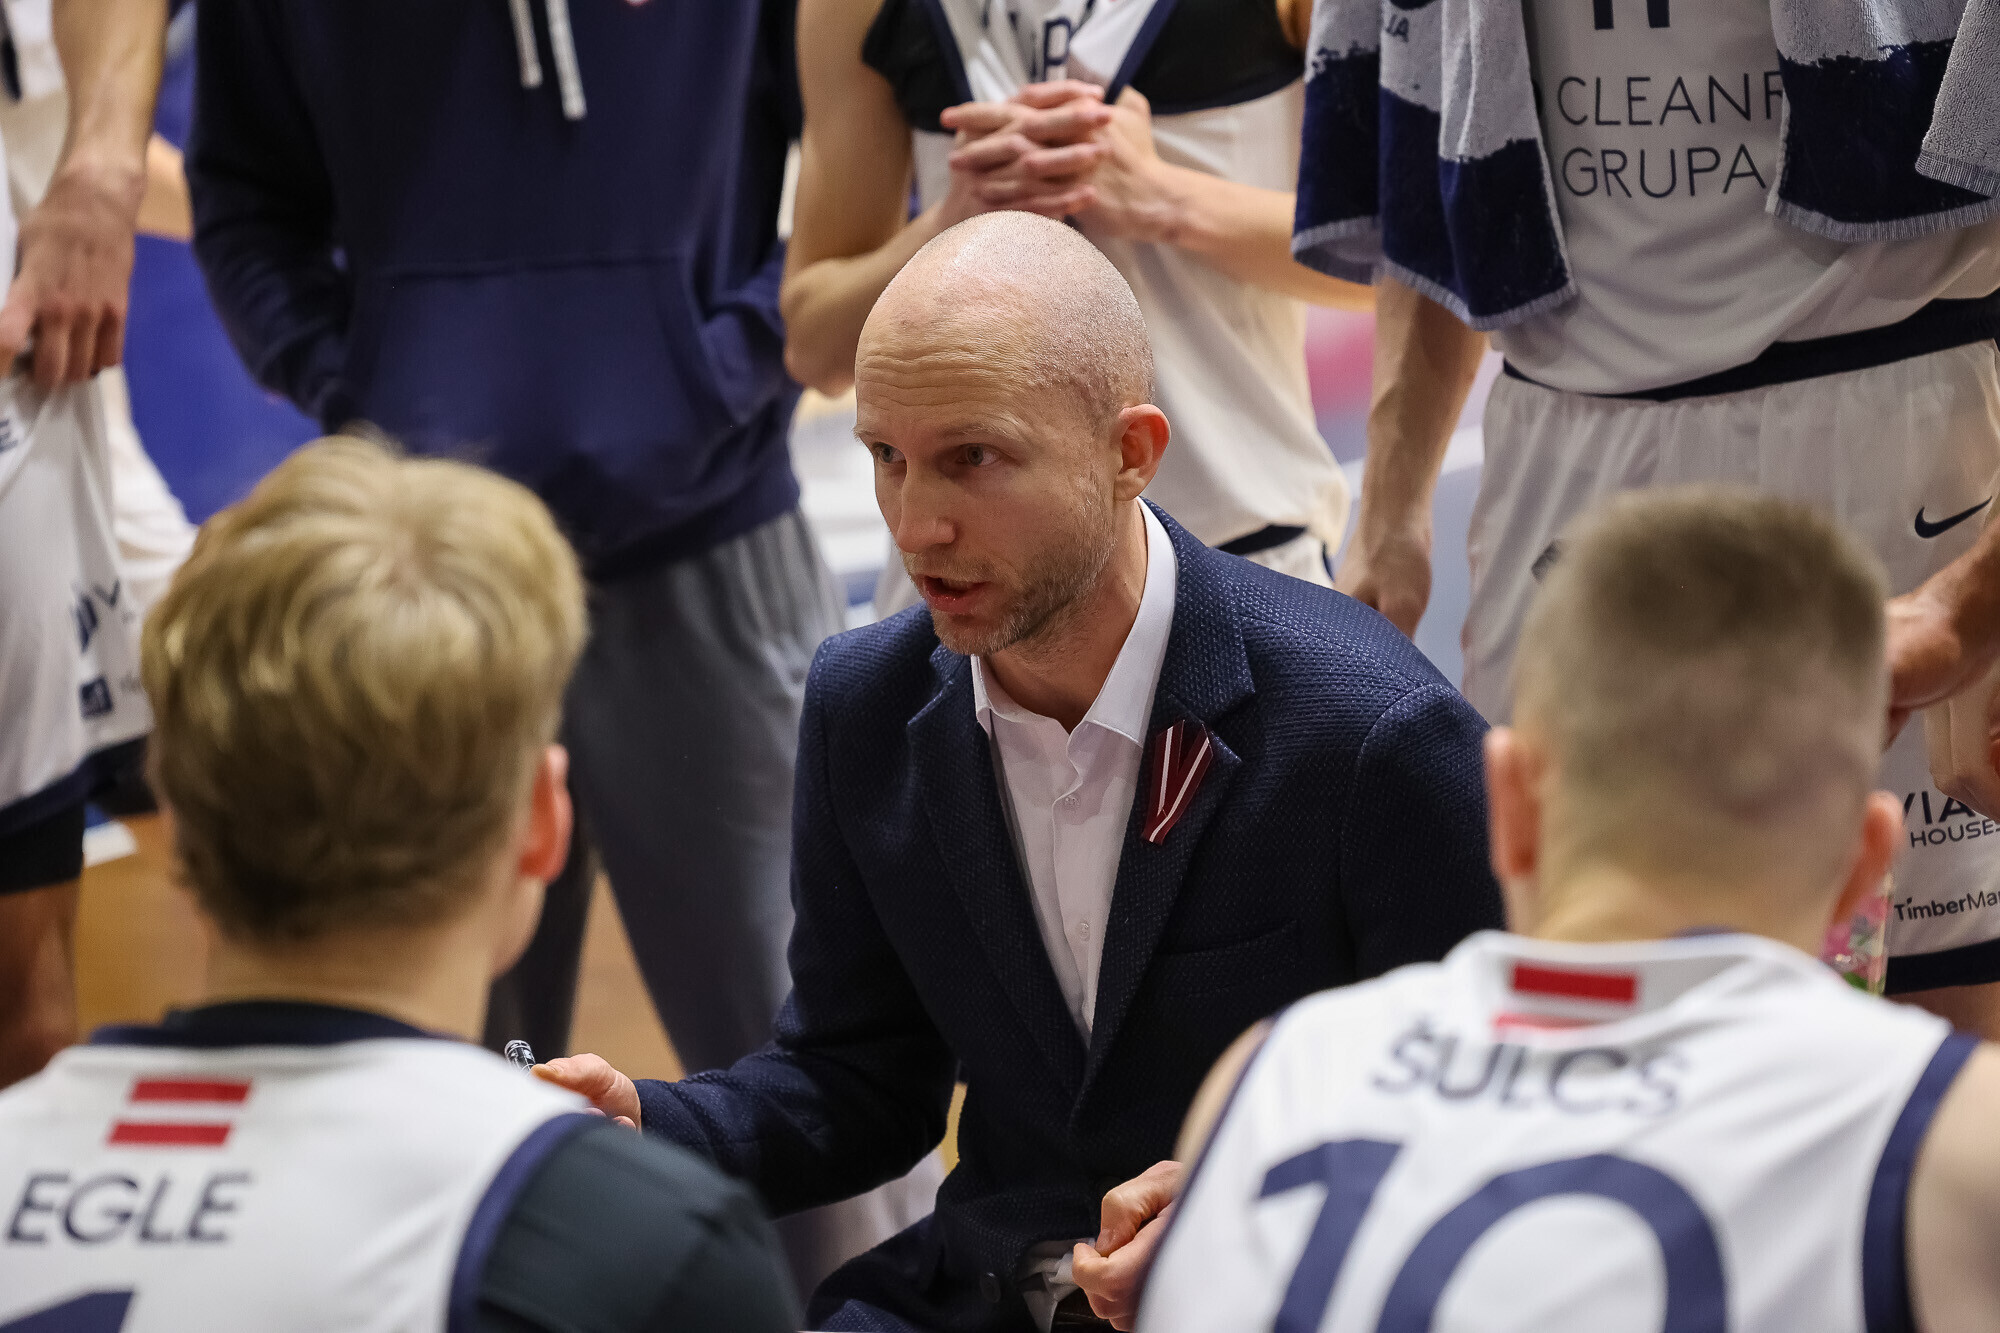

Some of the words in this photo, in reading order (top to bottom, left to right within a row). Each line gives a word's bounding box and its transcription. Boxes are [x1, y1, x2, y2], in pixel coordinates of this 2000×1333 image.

[1562, 143, 1767, 198] GRUPA
[1910, 818, 2000, 848] HOUSE
[1894, 890, 2000, 921] TimberMa
[1371, 1013, 1692, 1116] ŠULCS
[6, 1170, 252, 1244] EGLE
